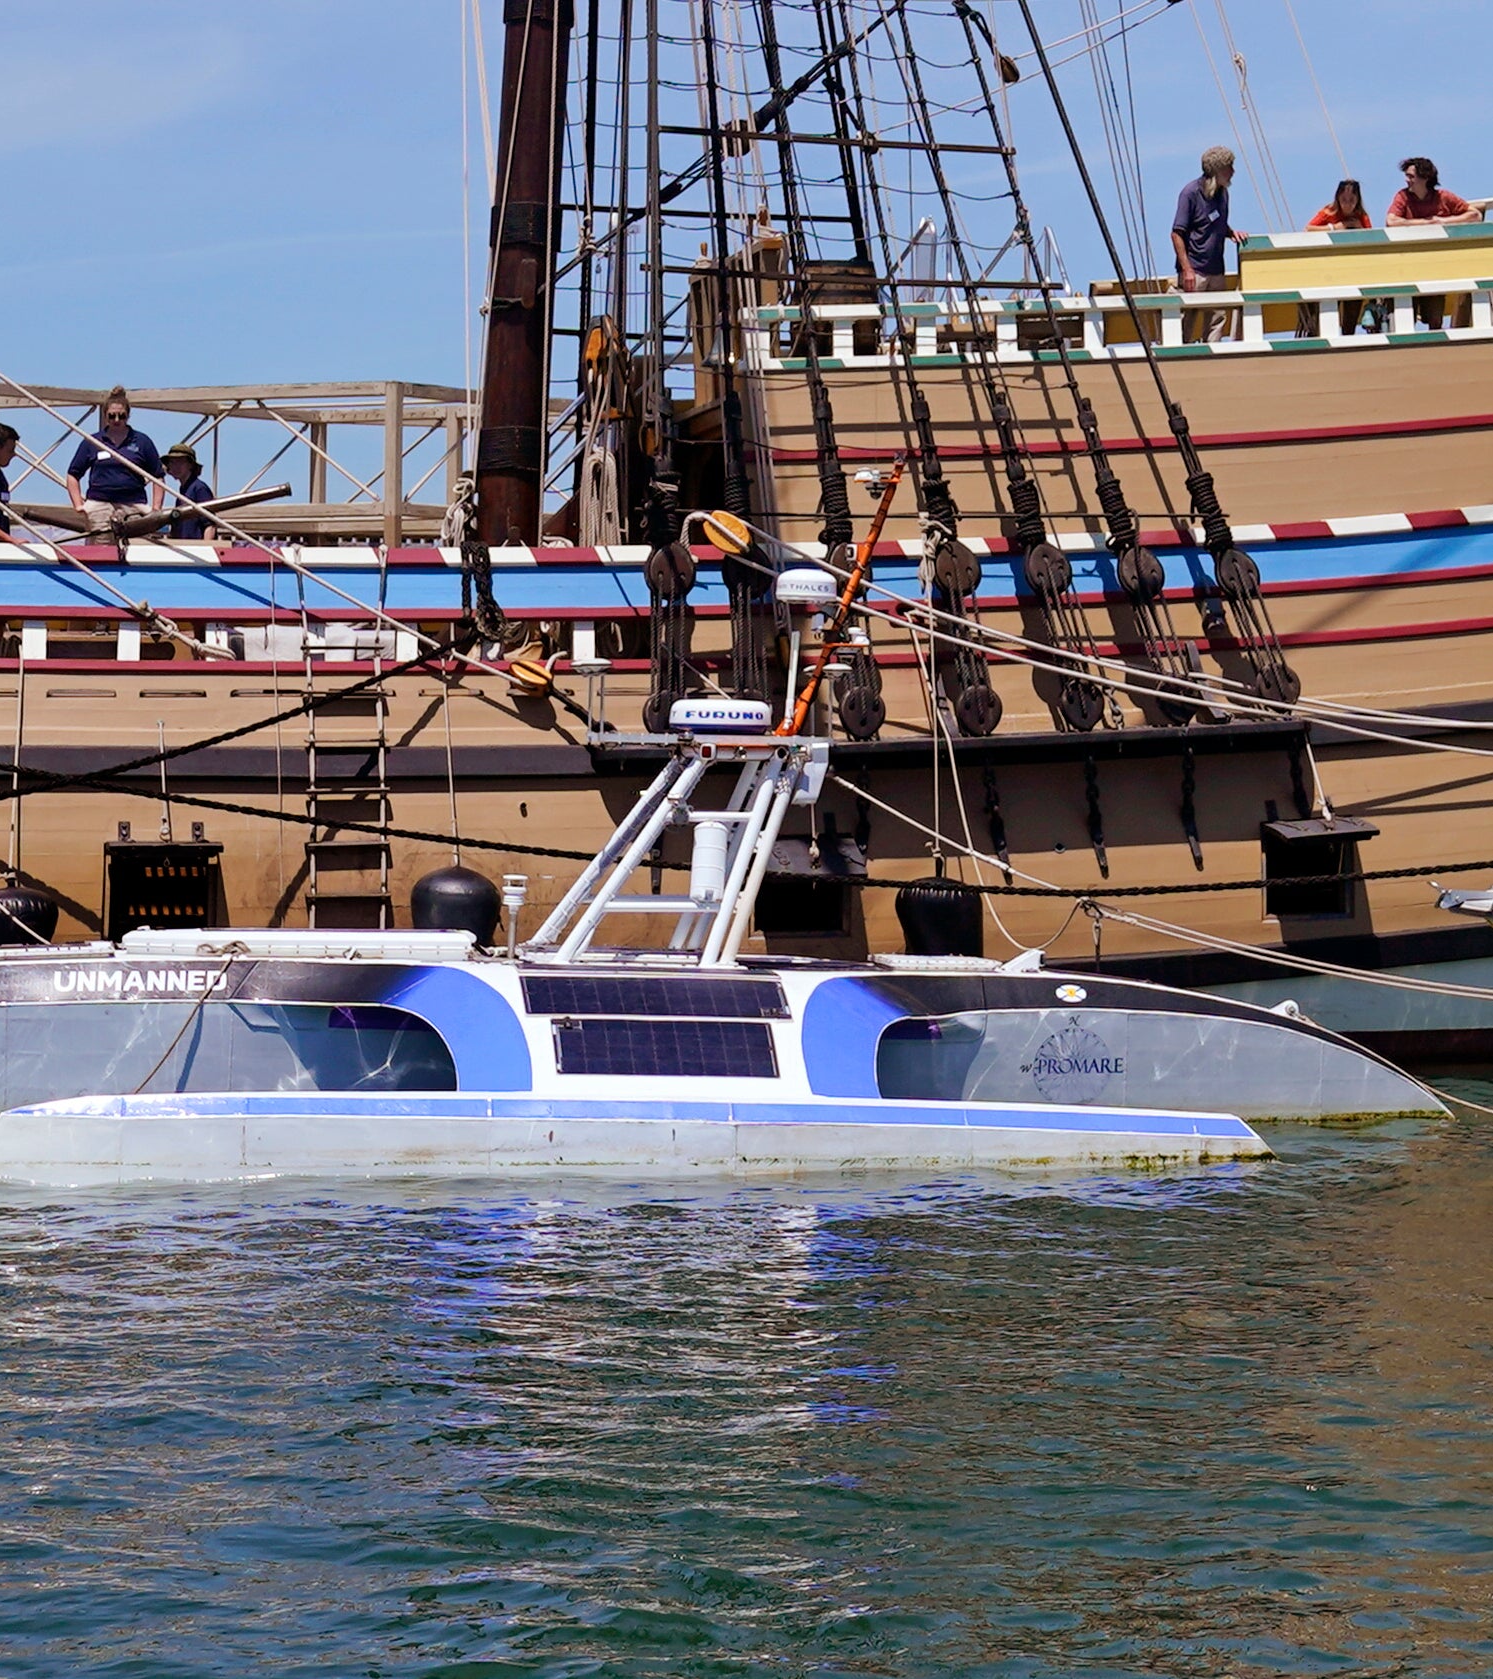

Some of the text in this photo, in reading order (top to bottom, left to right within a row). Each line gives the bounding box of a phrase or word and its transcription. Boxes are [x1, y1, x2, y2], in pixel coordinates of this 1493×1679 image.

[789, 583, 829, 592] THALES
[685, 711, 764, 720] FURUNO
[53, 970, 228, 993] UNMANNED
[1037, 1057, 1124, 1074] PROMARE
